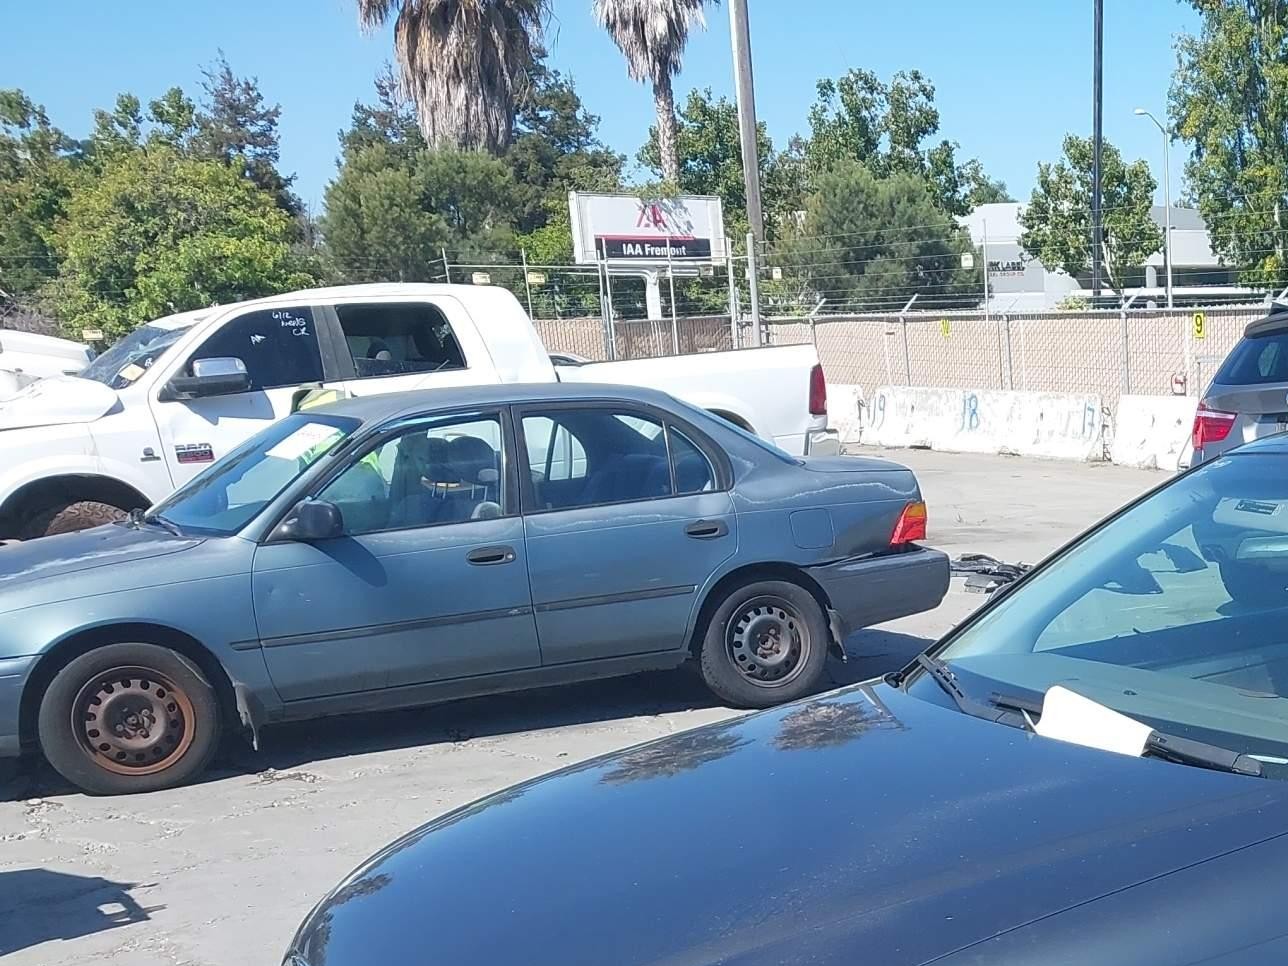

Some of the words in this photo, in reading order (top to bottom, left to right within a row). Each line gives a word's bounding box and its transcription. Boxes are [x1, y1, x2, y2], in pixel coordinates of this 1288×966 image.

[622, 243, 643, 256] IAA
[644, 243, 687, 256] Fremont
[1195, 314, 1203, 334] 9
[870, 394, 886, 430] 19
[959, 392, 979, 432] 18
[174, 442, 213, 451] RAM
